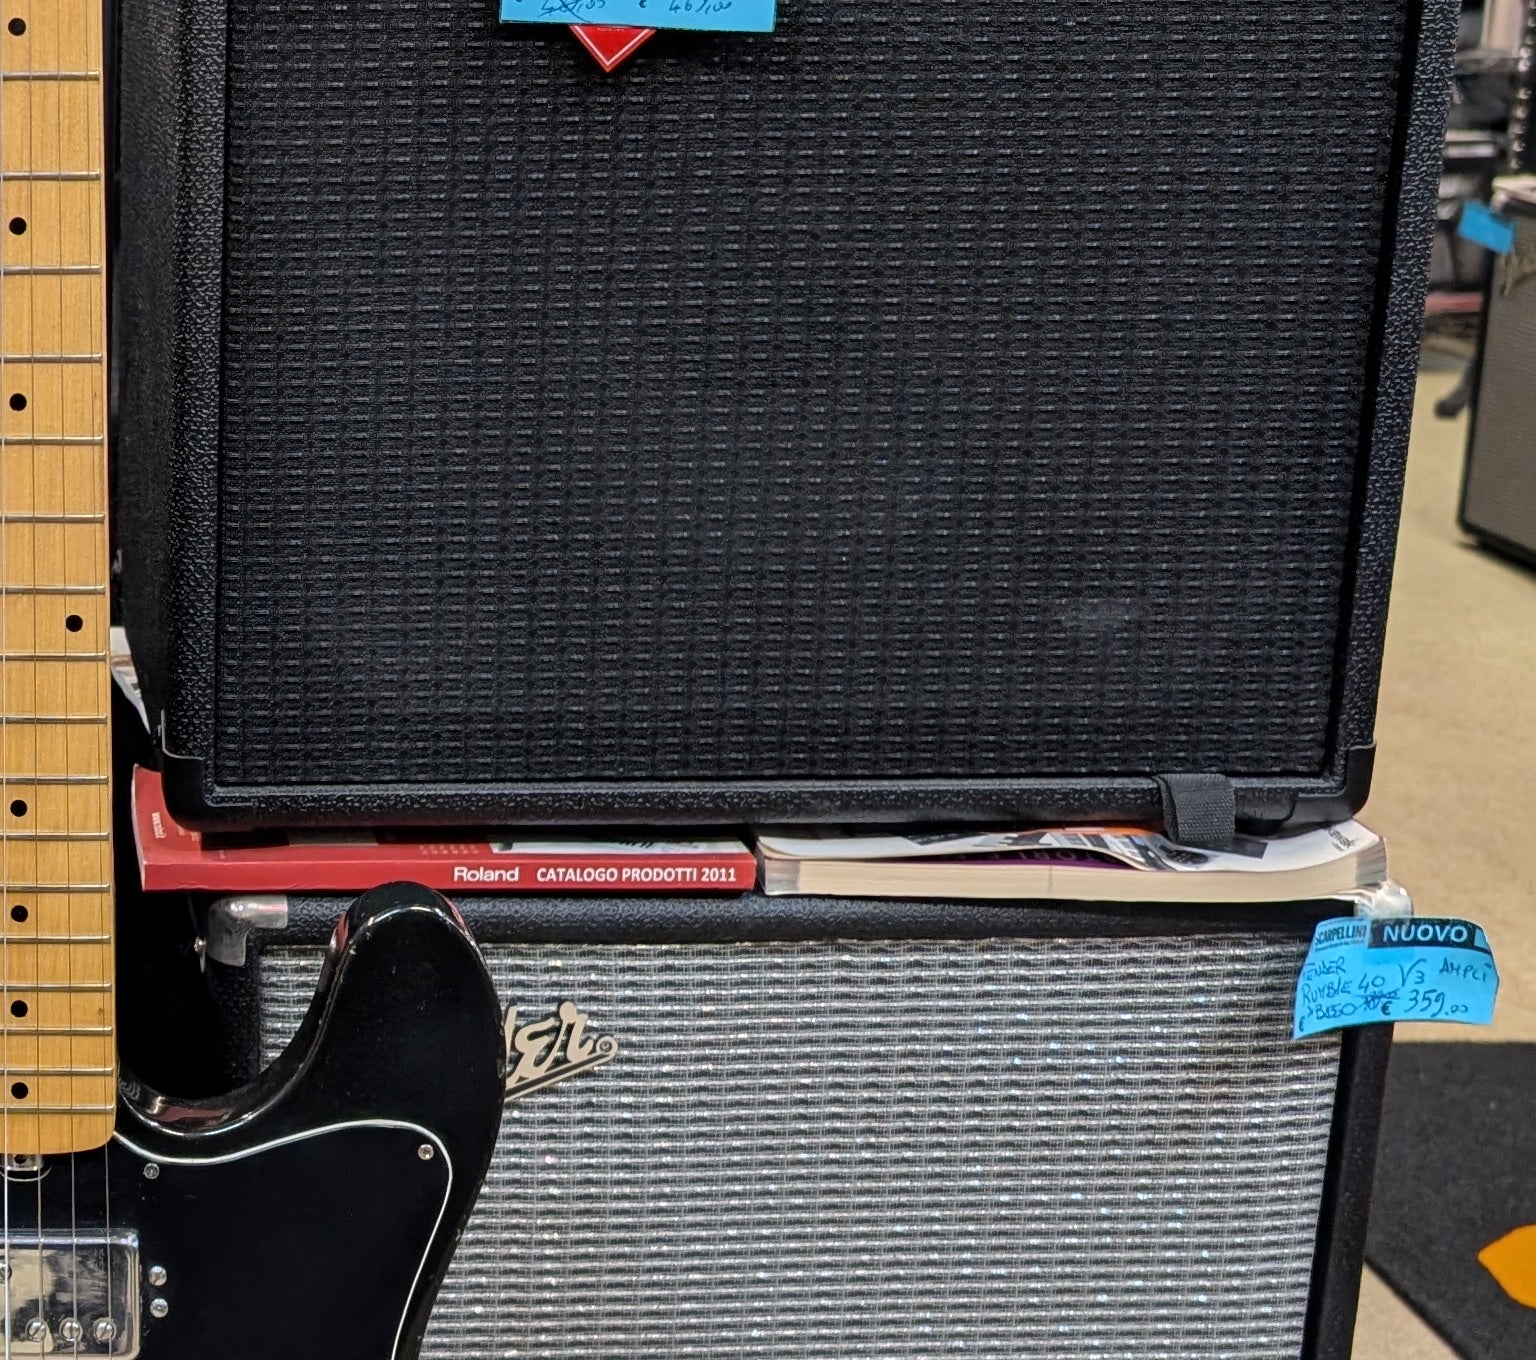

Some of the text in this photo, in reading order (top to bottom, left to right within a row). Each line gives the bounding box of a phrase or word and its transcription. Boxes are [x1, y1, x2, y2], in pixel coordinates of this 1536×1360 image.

[453, 865, 737, 883] Roland CATALOGO PRODOTTI 2011
[1383, 924, 1467, 943] NUOVO
[1358, 973, 1385, 993] 40
